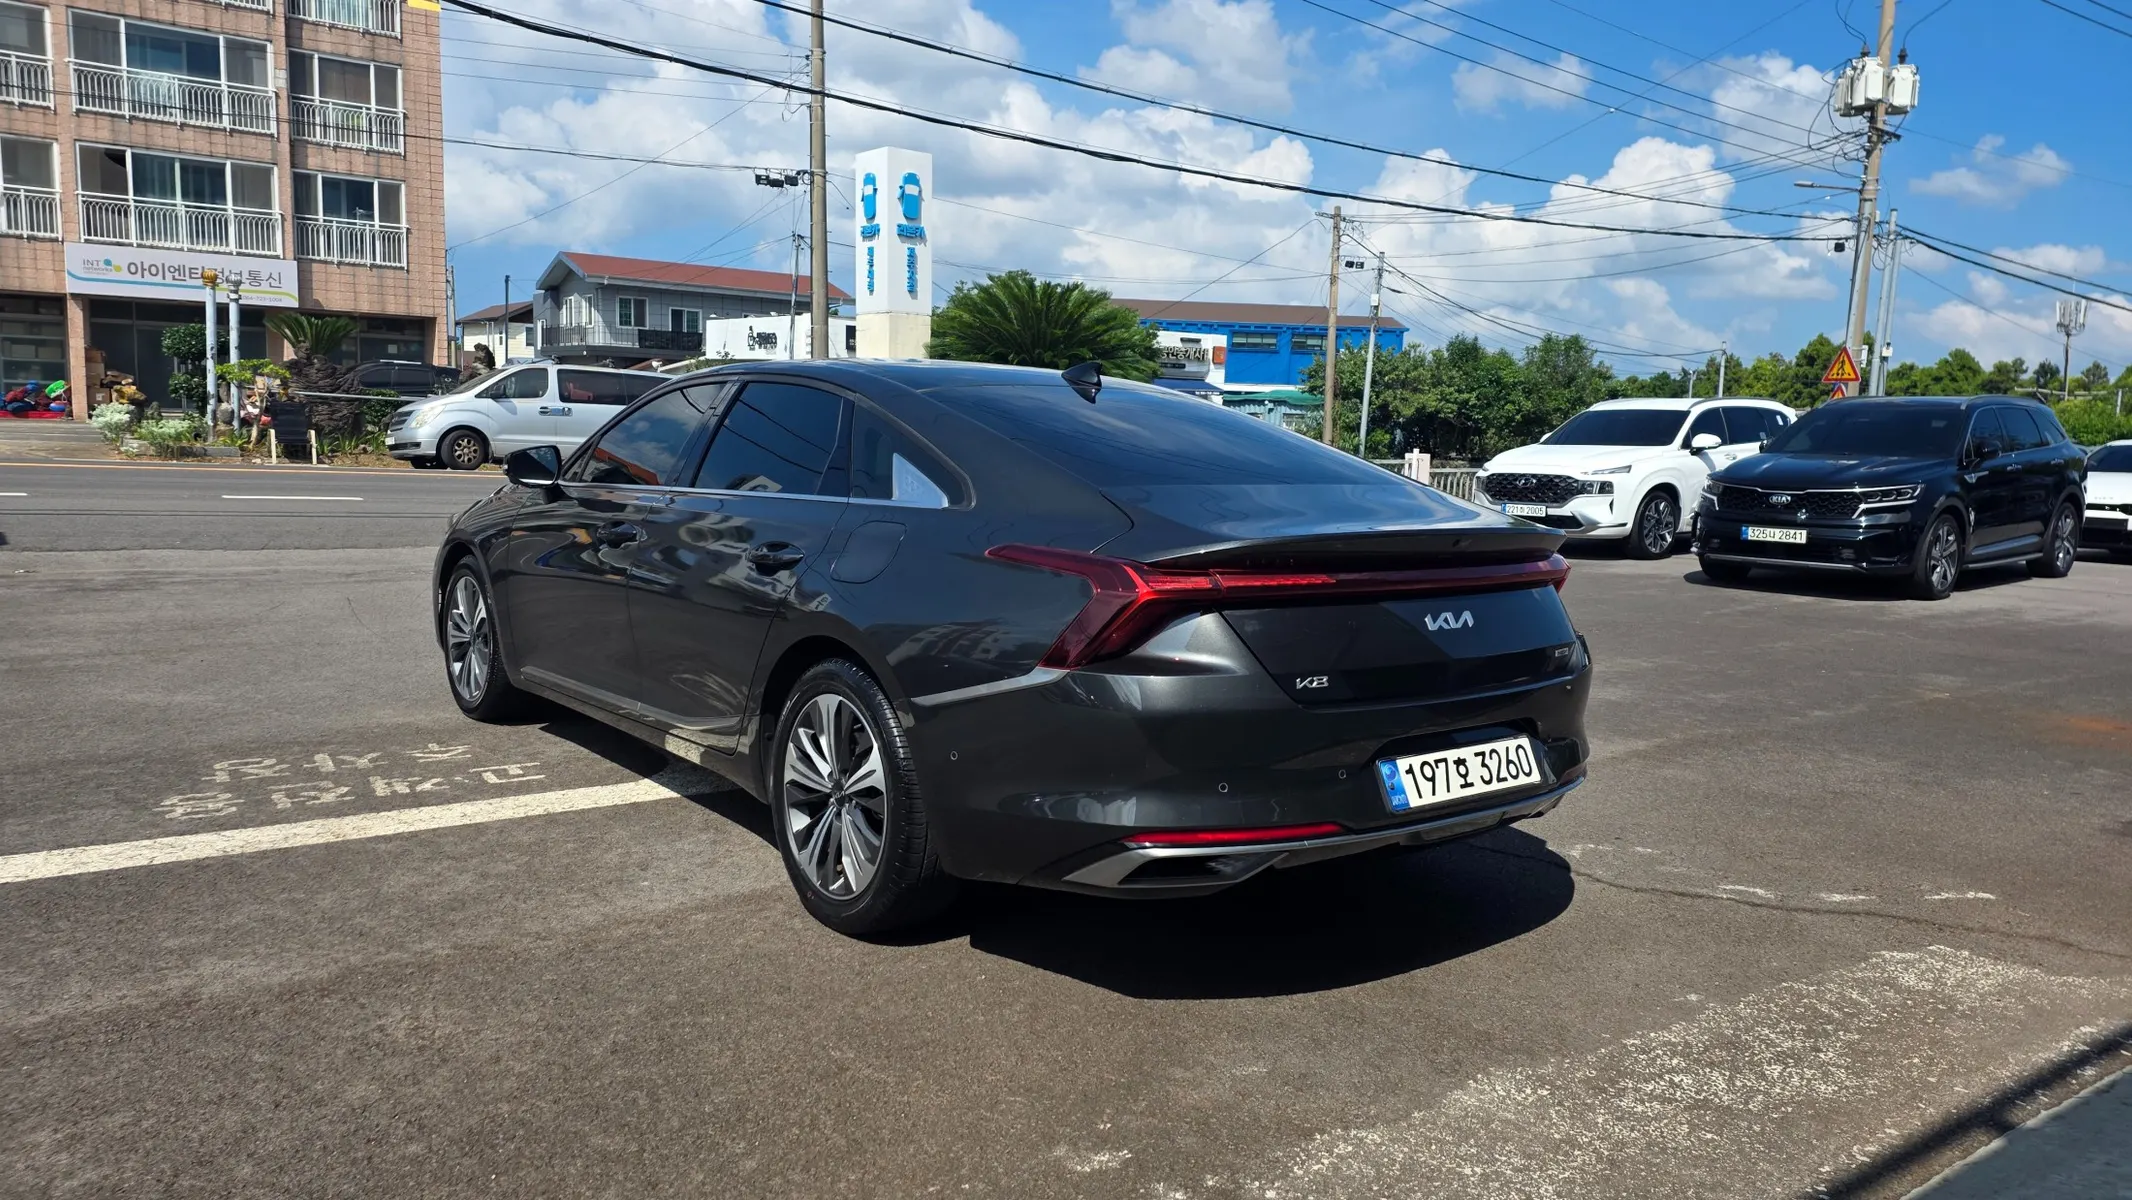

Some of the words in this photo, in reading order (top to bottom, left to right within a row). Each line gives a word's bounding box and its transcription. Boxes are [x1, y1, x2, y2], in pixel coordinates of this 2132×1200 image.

[82, 258, 101, 267] INT
[1526, 507, 1544, 515] 2005
[1749, 528, 1775, 539] 325나
[1778, 530, 1803, 541] 2841
[1425, 610, 1474, 631] KIA
[1296, 676, 1329, 689] K8
[1405, 757, 1475, 799] 197호
[1474, 744, 1533, 785] 3260
